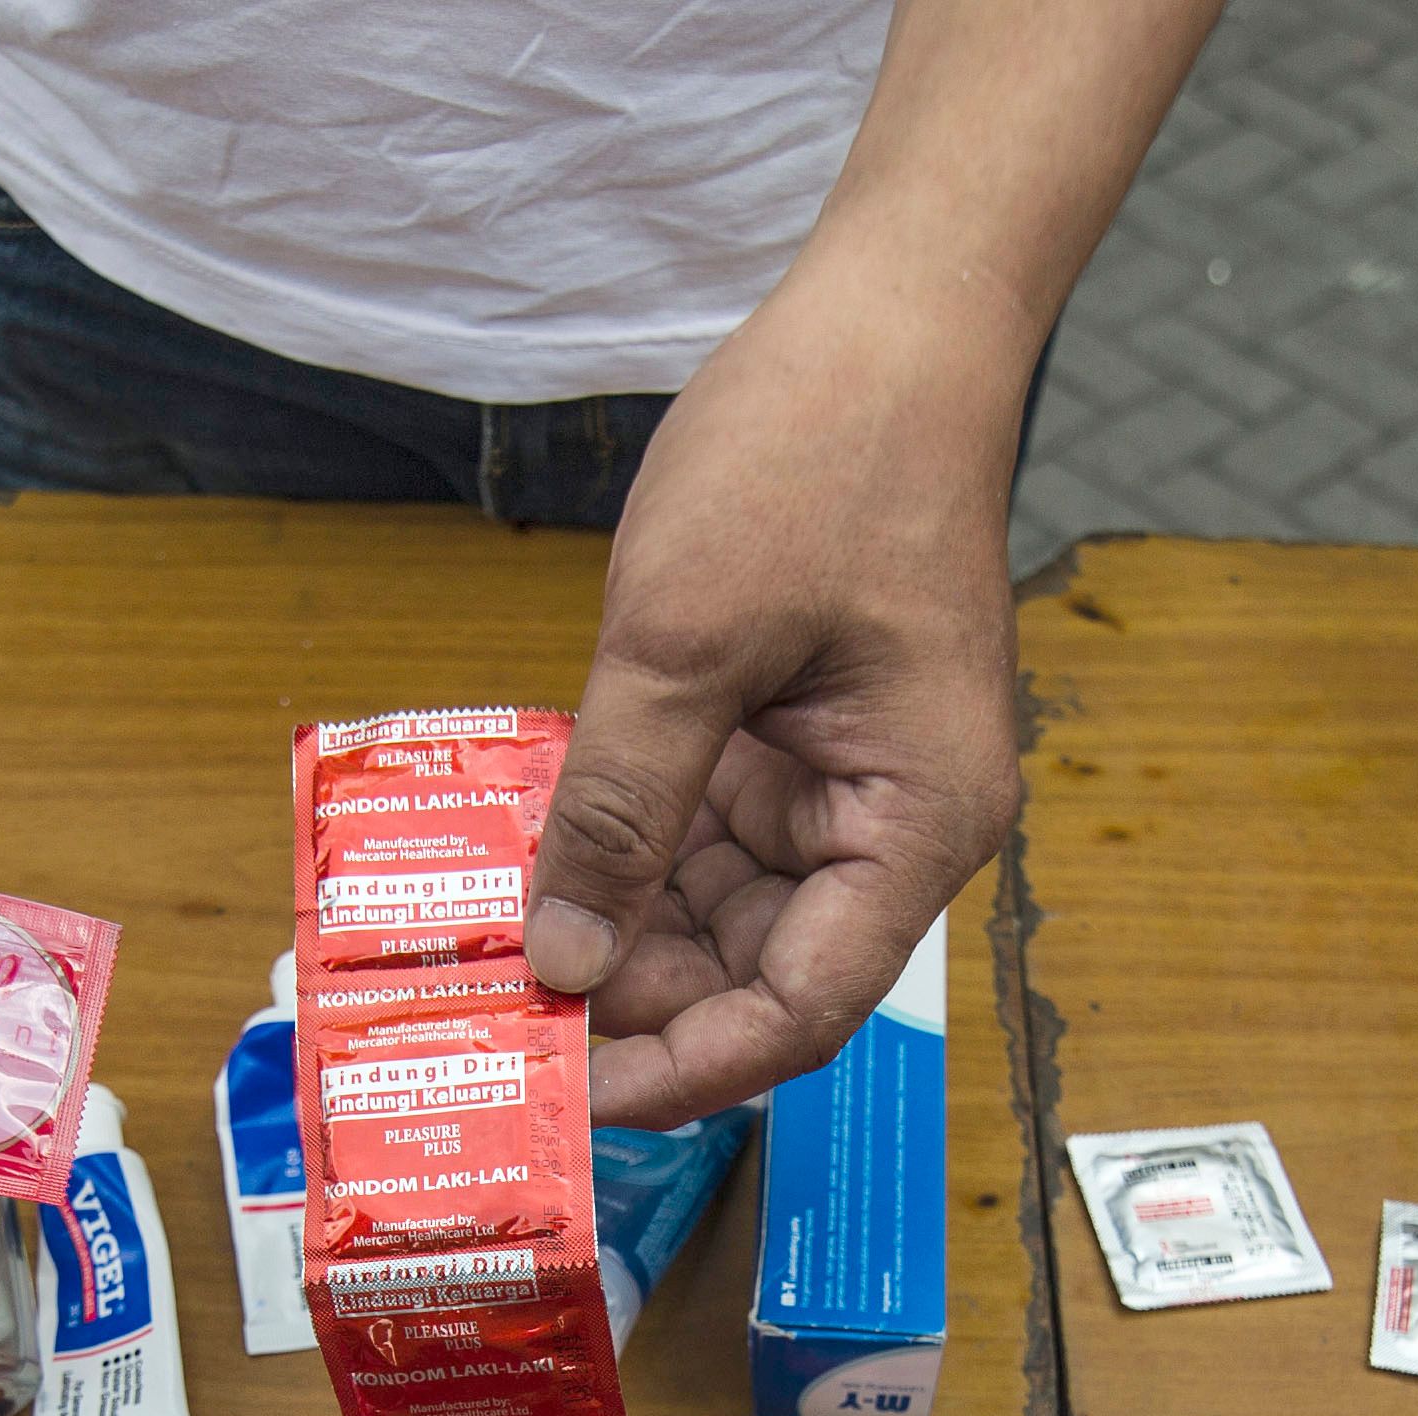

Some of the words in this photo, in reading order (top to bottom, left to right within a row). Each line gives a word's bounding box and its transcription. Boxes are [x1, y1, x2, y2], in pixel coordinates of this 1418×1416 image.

[323, 718, 410, 751] Lindungi
[416, 714, 509, 737] Keluarga
[378, 750, 452, 767] PLEASURE
[415, 763, 452, 776] PLUS
[316, 795, 408, 818] KONDOM
[415, 792, 519, 810] LAKI-LAKI
[343, 849, 399, 863] Mercator
[403, 845, 462, 859] Healthcare
[464, 844, 489, 856] Ltd.
[364, 837, 446, 850] Manufactured
[449, 836, 468, 848] by:
[322, 876, 447, 900] Lindungi
[462, 872, 515, 890] Diri
[322, 903, 414, 927] Lindungi
[419, 898, 516, 921] Keluarga
[381, 937, 457, 955] PLEASURE
[422, 953, 459, 968] PLUS
[317, 987, 415, 1007] KONDOM
[421, 979, 524, 998] LAKI-LAKI
[348, 1035, 400, 1050] Mercator
[403, 1031, 464, 1044] Healthcare
[468, 1027, 492, 1039] Ltd.
[368, 1021, 449, 1038] Manufactured
[451, 1018, 471, 1032] by:
[324, 1061, 449, 1089] Lindungi
[464, 1055, 516, 1075] Diri
[325, 1089, 418, 1115] Lindungi
[423, 1081, 518, 1106] Keluarga
[385, 1124, 461, 1144] PLEASURE
[423, 1139, 461, 1155] PLUS
[324, 1173, 418, 1198] KONDOM
[423, 1166, 528, 1186] LAKI-LAKI
[72, 1179, 125, 1319] VIGEL
[405, 1322, 479, 1339] PLEASURE
[445, 1336, 482, 1351] PLUS
[352, 1368, 445, 1387] KONDOM
[451, 1358, 554, 1378] LAKI-LAKI
